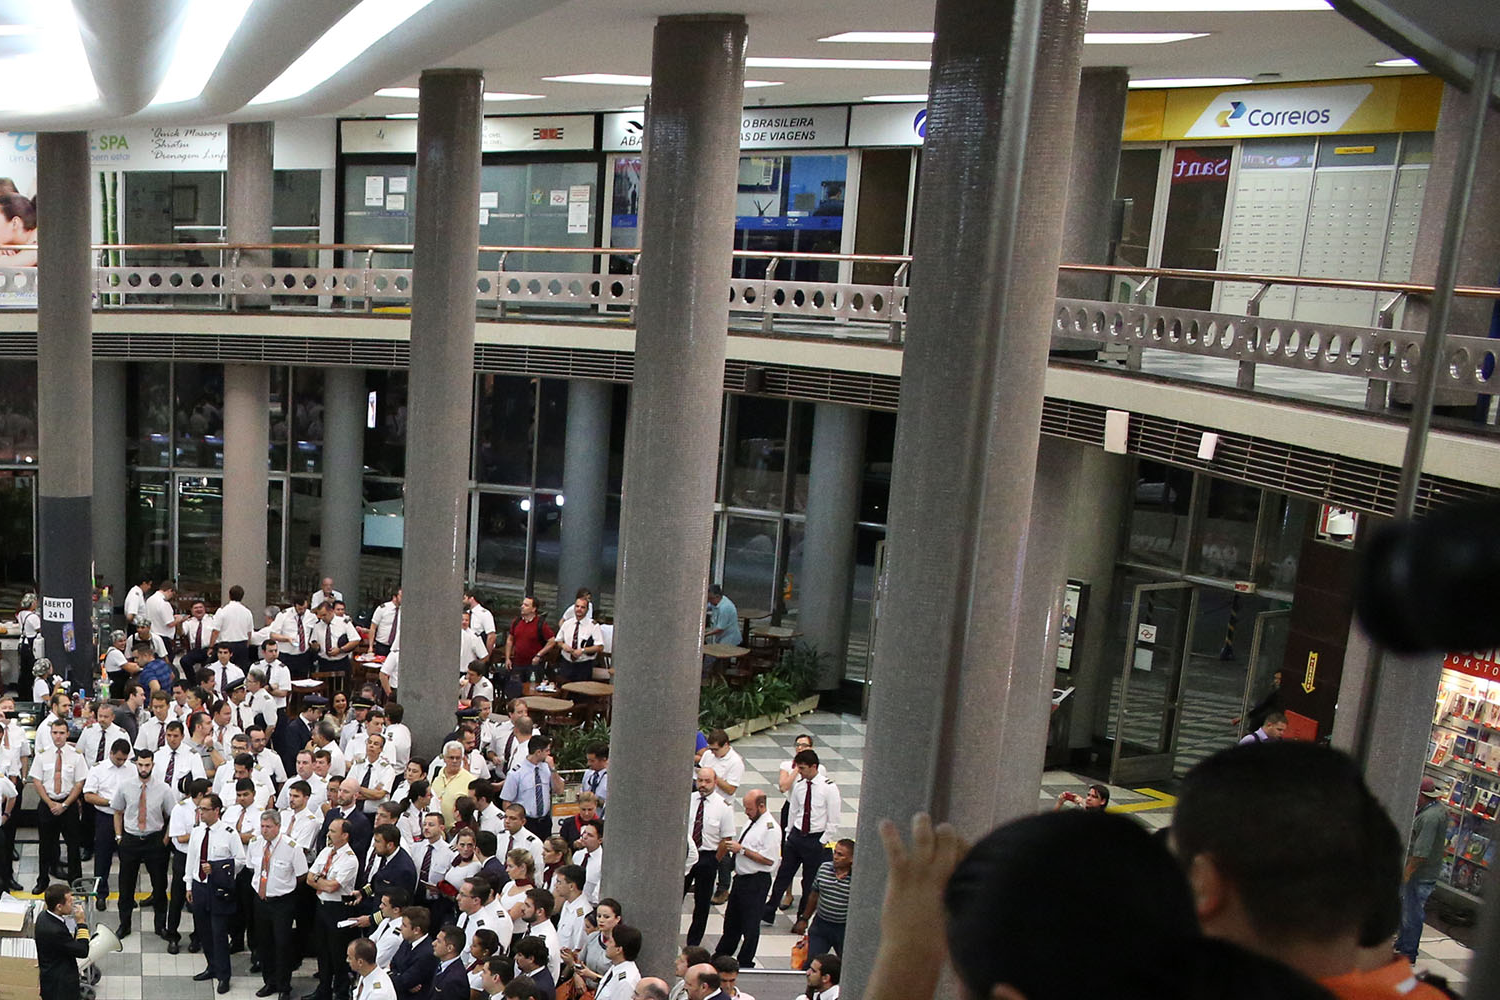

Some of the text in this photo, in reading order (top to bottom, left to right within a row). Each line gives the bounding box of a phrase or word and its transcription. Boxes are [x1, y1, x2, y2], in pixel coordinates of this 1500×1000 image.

[753, 117, 814, 128] BRASILEIRA
[1248, 108, 1331, 127] Correios
[753, 133, 767, 142] DE
[770, 131, 816, 142] VIAGENS
[100, 135, 129, 150] SPA
[44, 600, 72, 608] ABERTO
